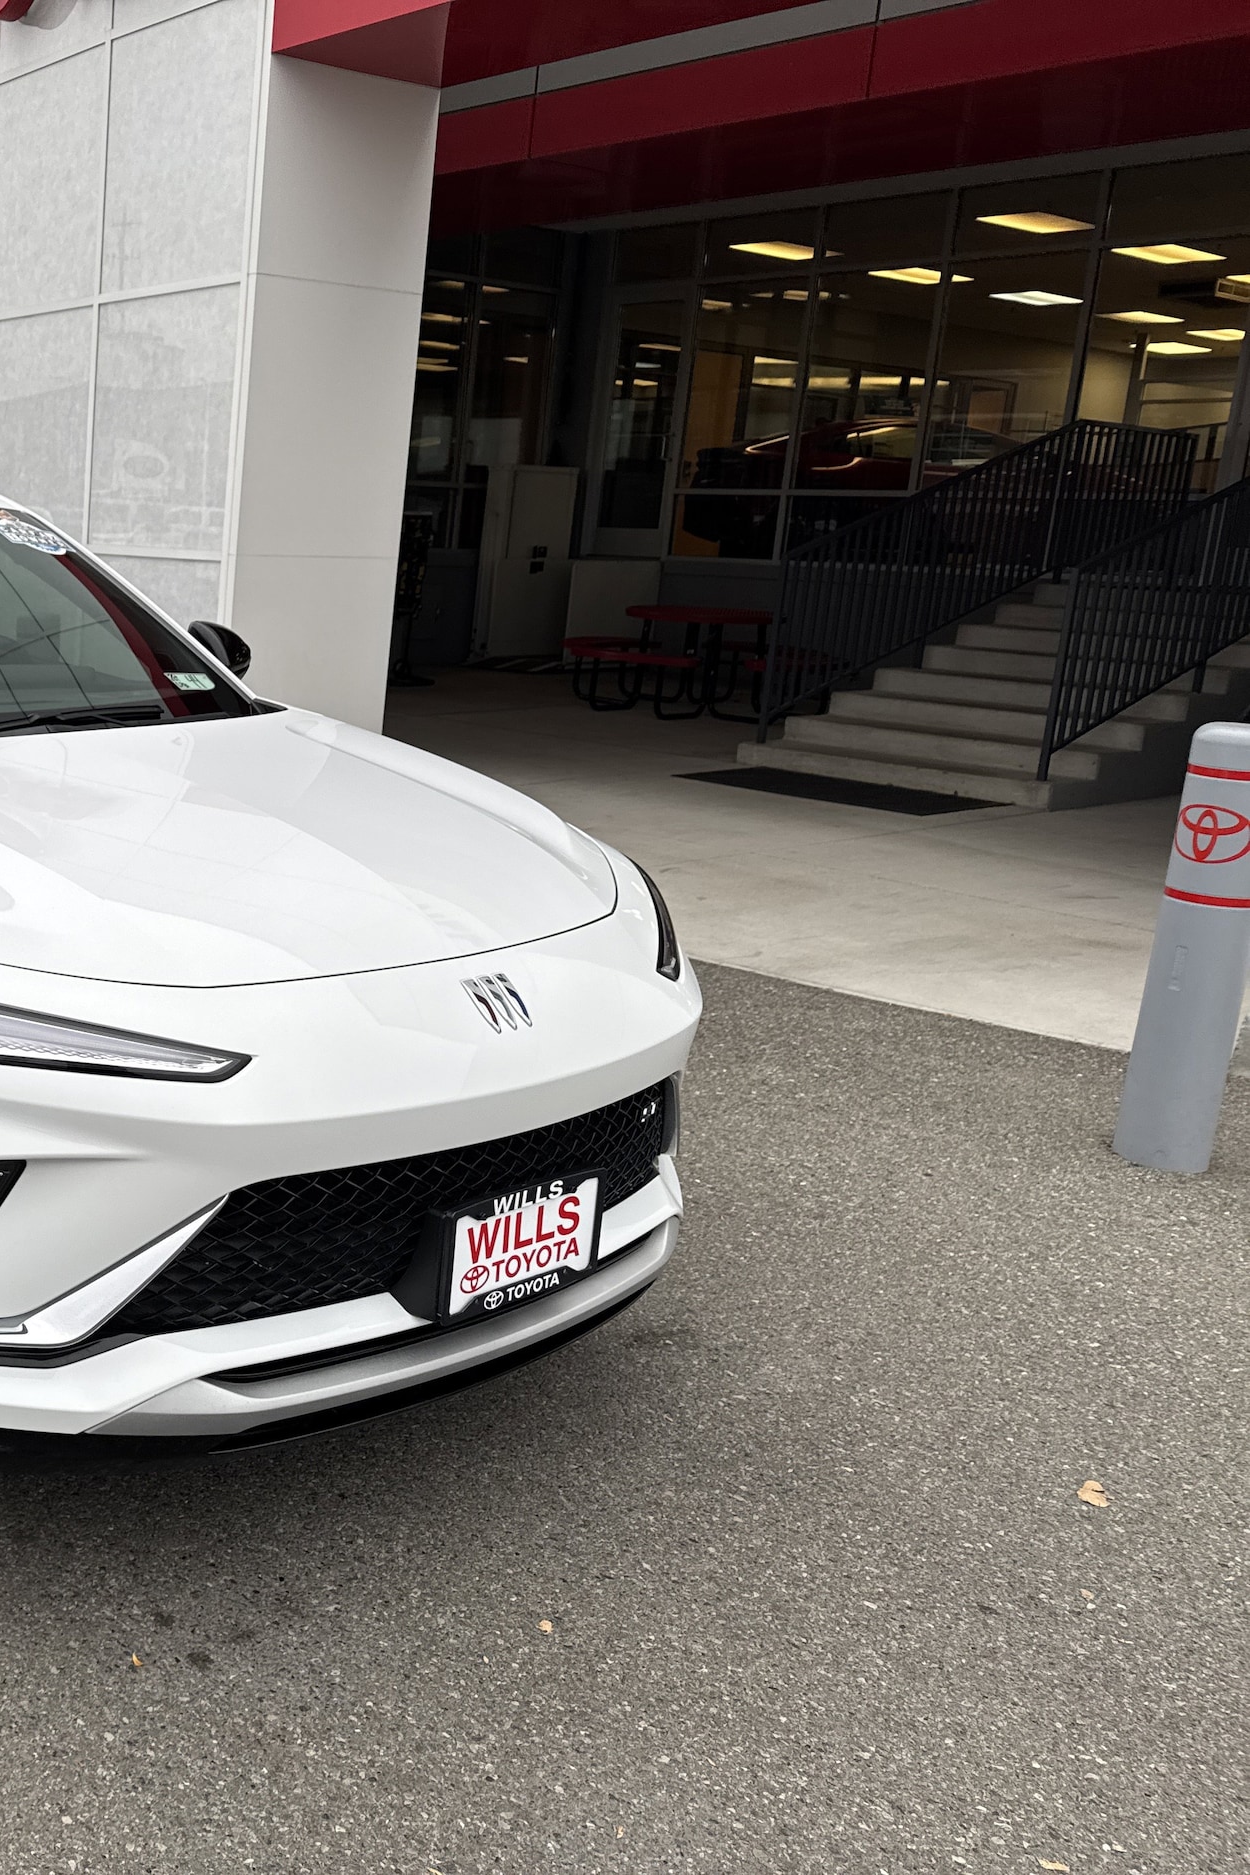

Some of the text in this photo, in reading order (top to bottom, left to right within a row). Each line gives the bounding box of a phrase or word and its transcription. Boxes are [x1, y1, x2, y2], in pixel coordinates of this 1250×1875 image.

[493, 1180, 564, 1217] WILLS
[467, 1196, 581, 1265] WILLS
[492, 1237, 580, 1283] TOYOTA
[506, 1272, 560, 1302] TOYOTA
